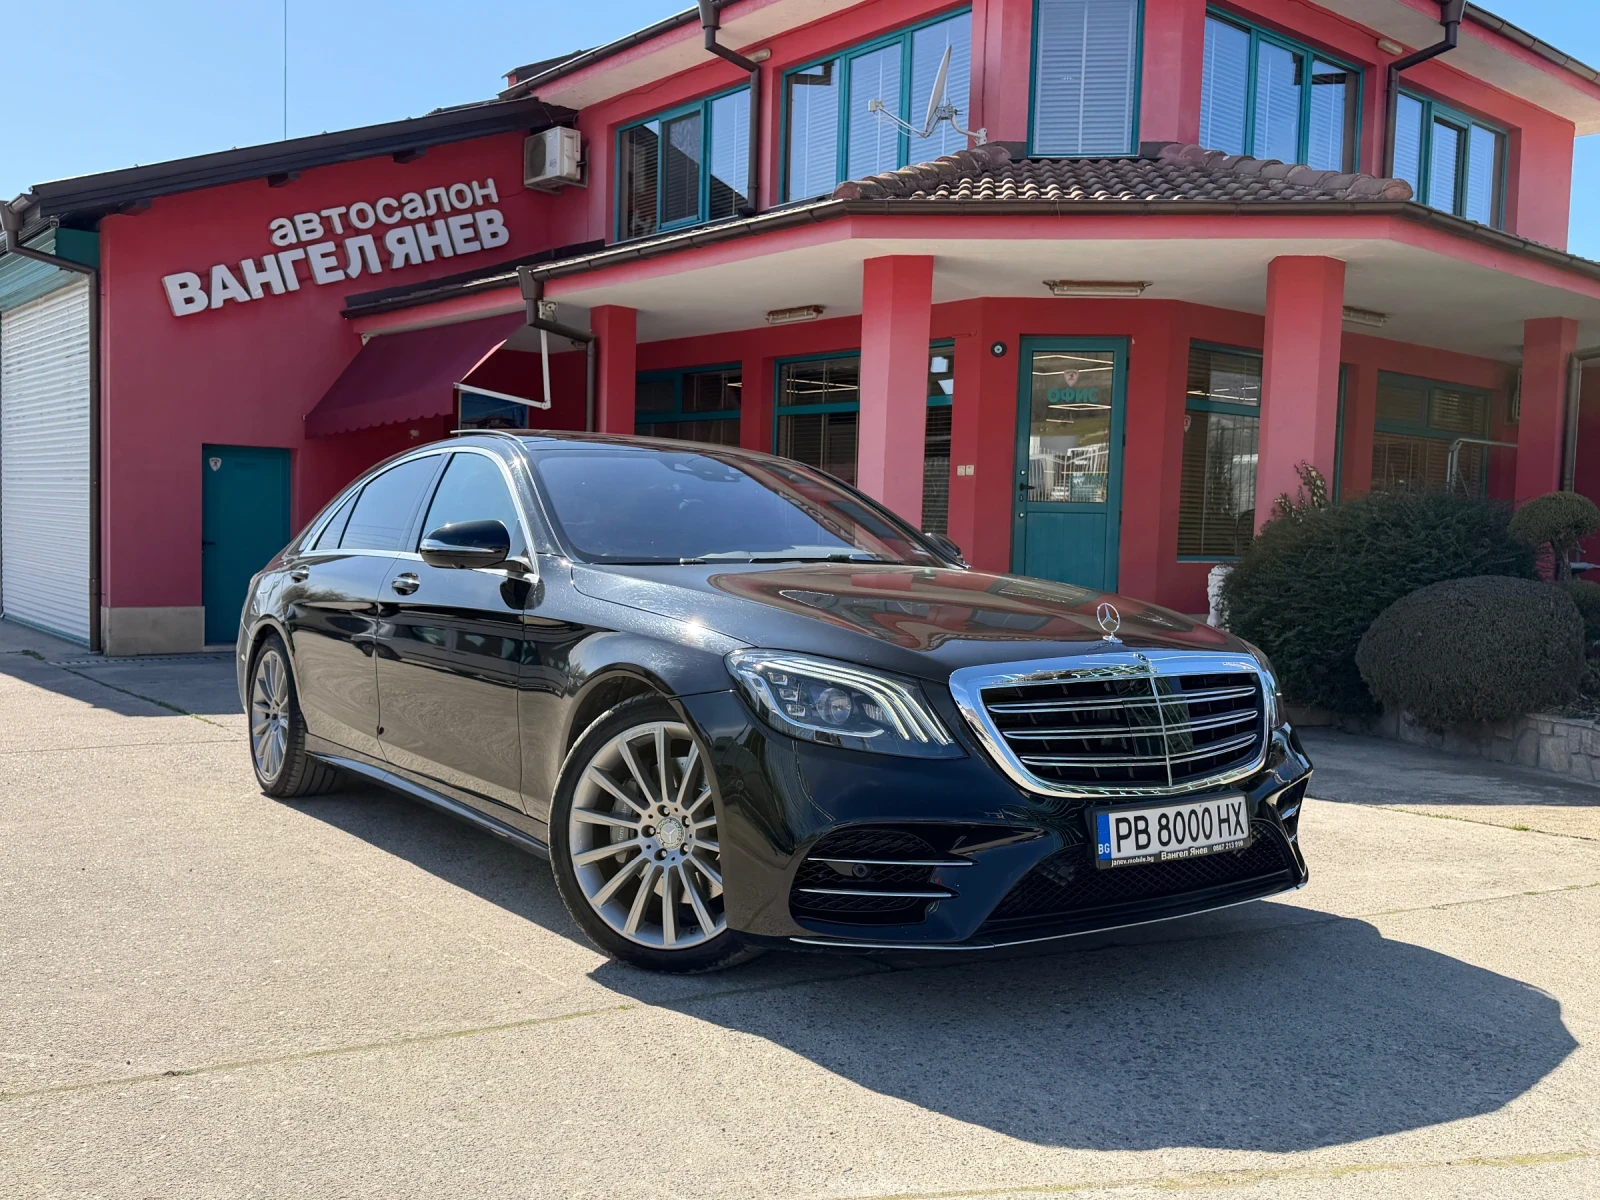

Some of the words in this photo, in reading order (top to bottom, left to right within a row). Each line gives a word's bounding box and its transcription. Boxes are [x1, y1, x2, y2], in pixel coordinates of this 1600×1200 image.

[269, 178, 499, 246] автосалон
[161, 234, 382, 317] ВАНГЕЛ
[384, 209, 510, 269] ЯНЕВ
[1047, 387, 1099, 403] ОФИС
[1115, 815, 1151, 853] PB
[1157, 807, 1213, 847] 8000
[1217, 801, 1245, 838] HX
[1098, 843, 1110, 855] BG
[1161, 850, 1188, 860] Вангел
[1190, 847, 1208, 856] Янев
